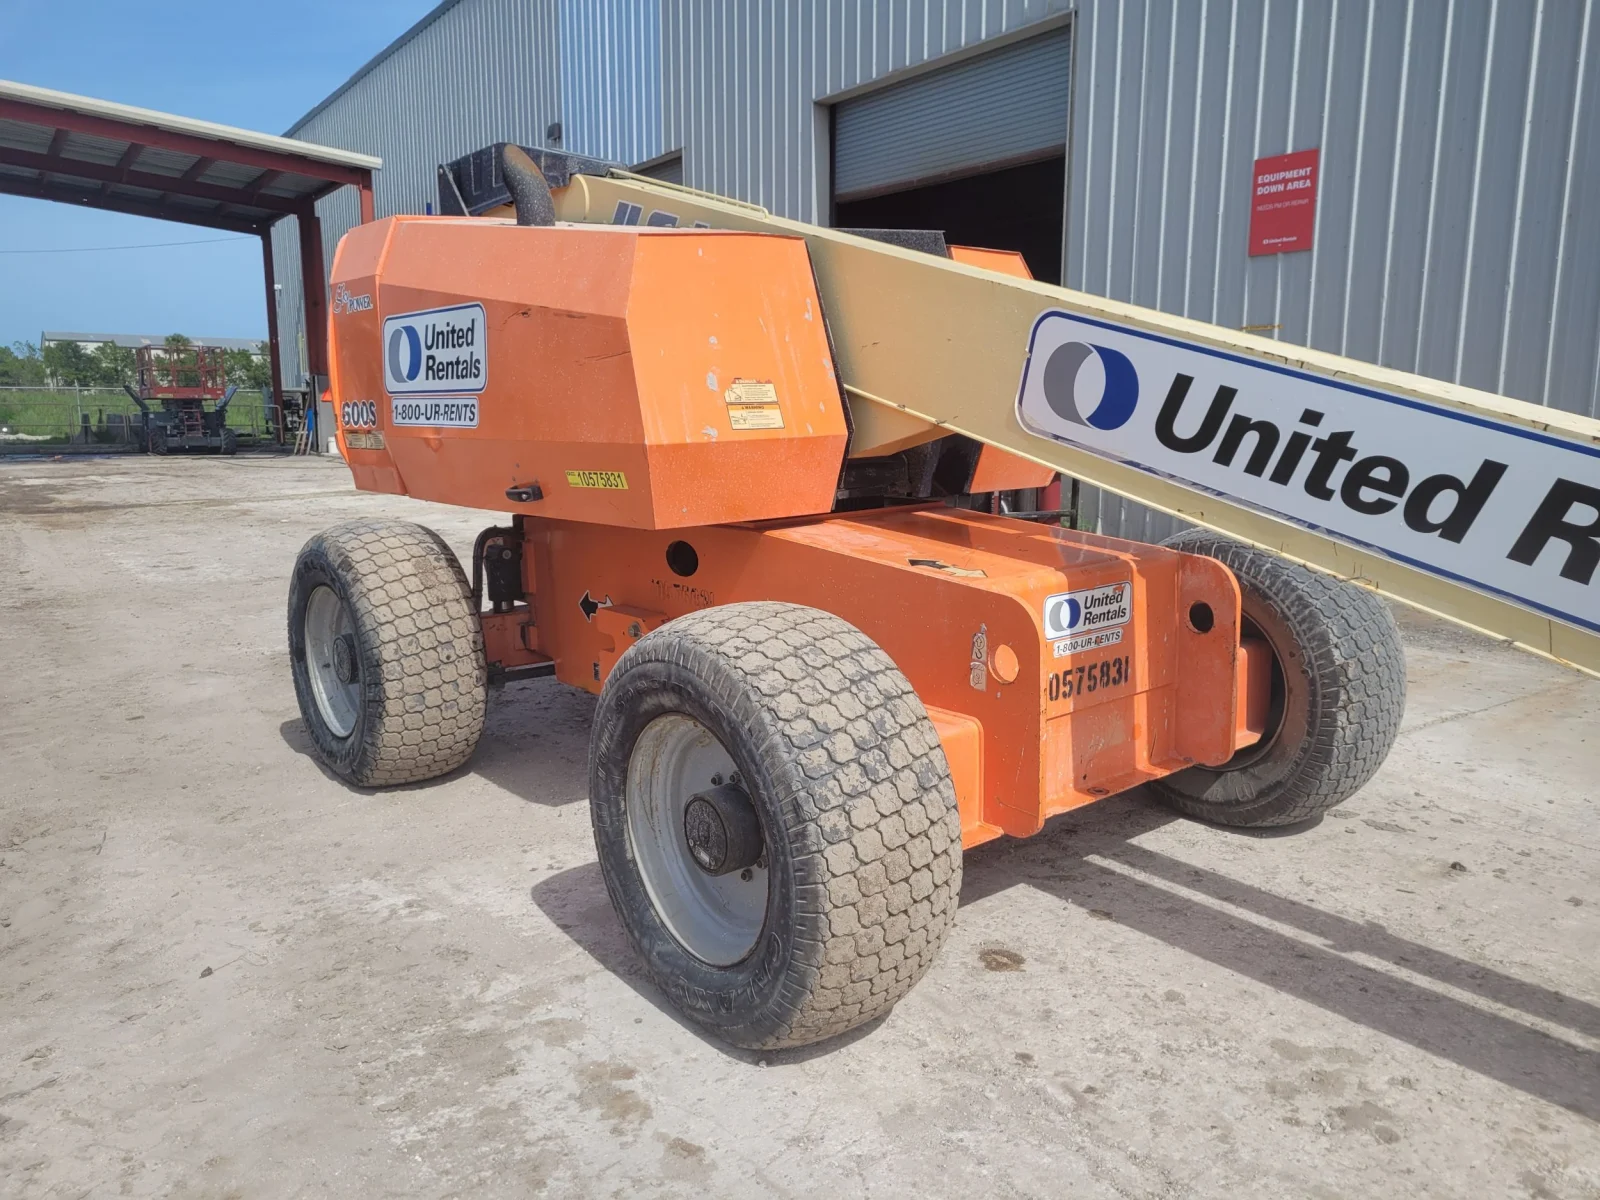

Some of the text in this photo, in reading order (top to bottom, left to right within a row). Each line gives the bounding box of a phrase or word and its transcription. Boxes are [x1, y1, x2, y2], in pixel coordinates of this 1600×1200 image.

[1258, 167, 1312, 184] EQUIPMENT
[1257, 179, 1311, 195] DOWN AREA
[424, 318, 475, 351] United
[425, 351, 481, 381] Rentals
[342, 401, 377, 427] 600S
[394, 403, 476, 422] 1-800-UR-RENTS
[1155, 373, 1509, 544] United
[577, 472, 625, 488] 10575831
[1084, 589, 1124, 610] United
[1083, 605, 1127, 626] Rentals
[1049, 656, 1129, 701] 0575831
